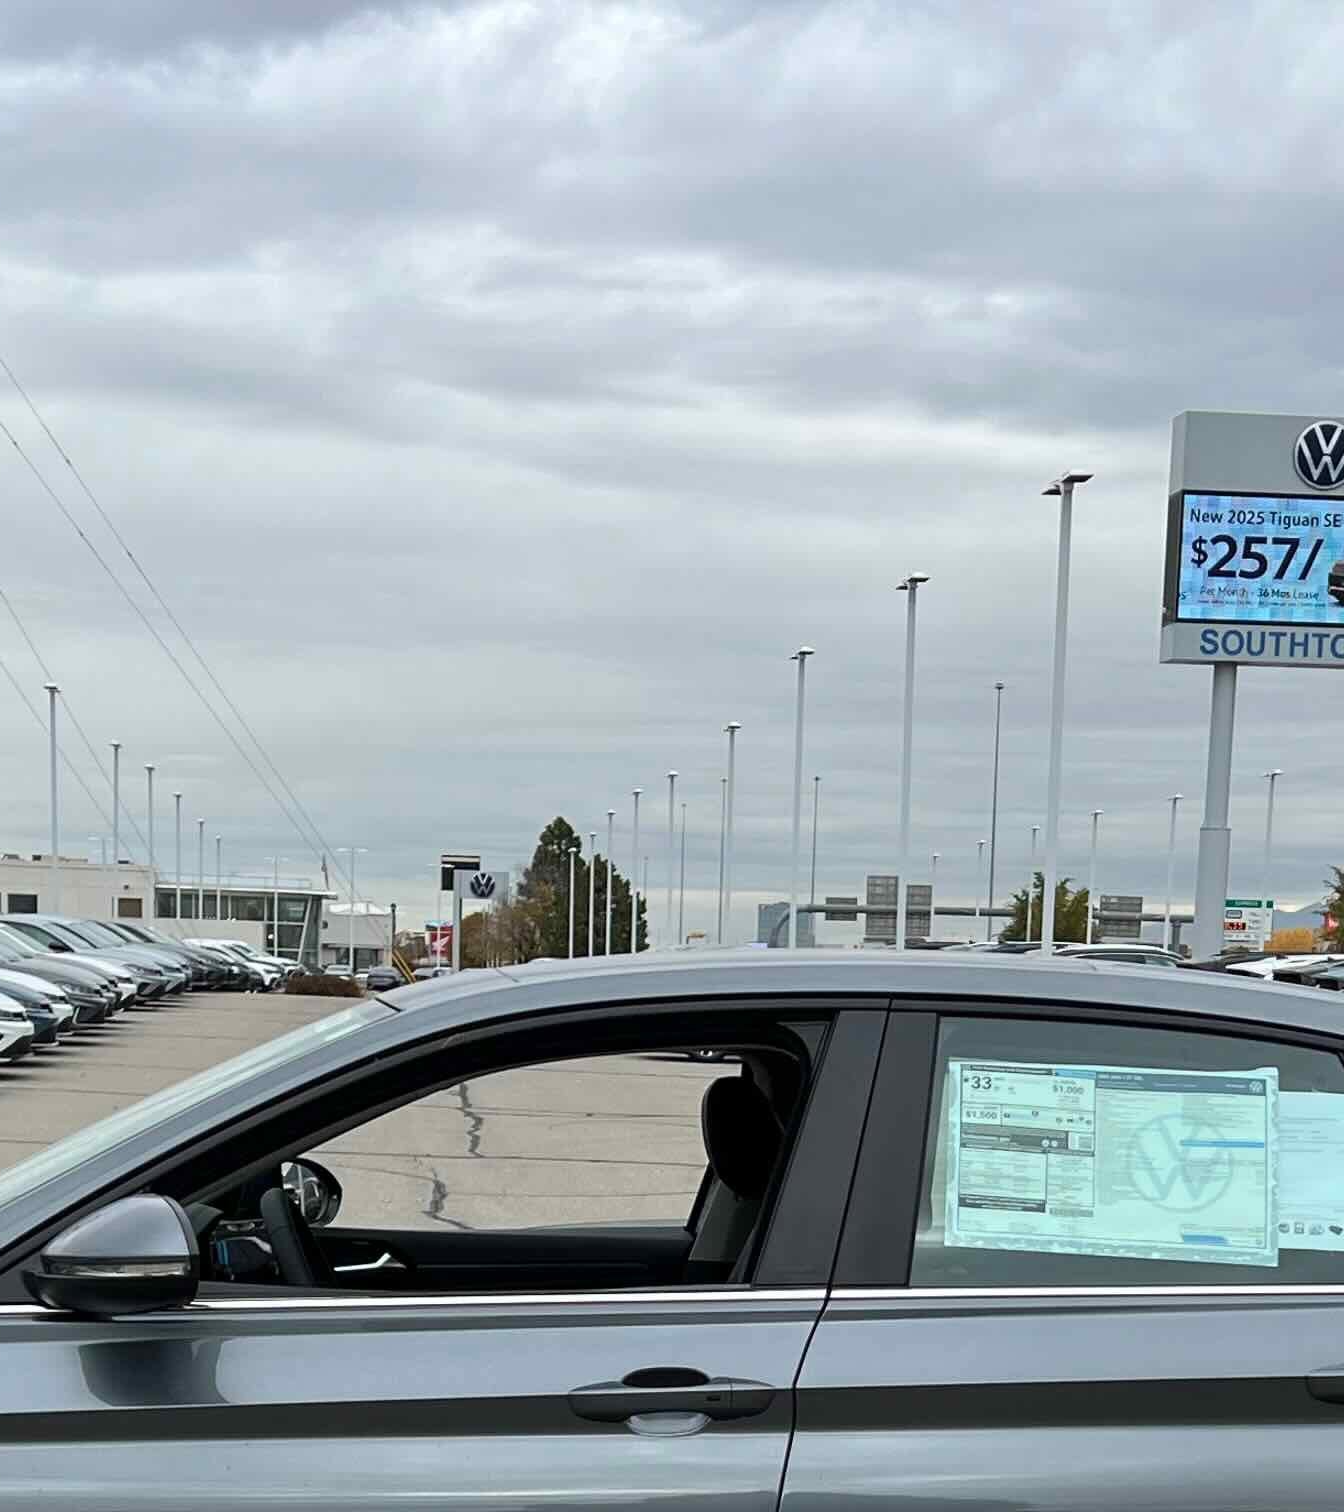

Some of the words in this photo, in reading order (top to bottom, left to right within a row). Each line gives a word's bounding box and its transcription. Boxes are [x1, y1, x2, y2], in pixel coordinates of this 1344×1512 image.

[1190, 508, 1222, 523] New
[1227, 510, 1265, 525] 2025
[1270, 511, 1319, 530] Tiguan
[1323, 513, 1343, 528] SE
[1199, 585, 1215, 596] Per
[1218, 586, 1249, 598] Month
[1257, 588, 1269, 598] 36
[1271, 589, 1290, 599] Mos
[1292, 589, 1320, 601] Lease
[970, 1076, 992, 1091] 33
